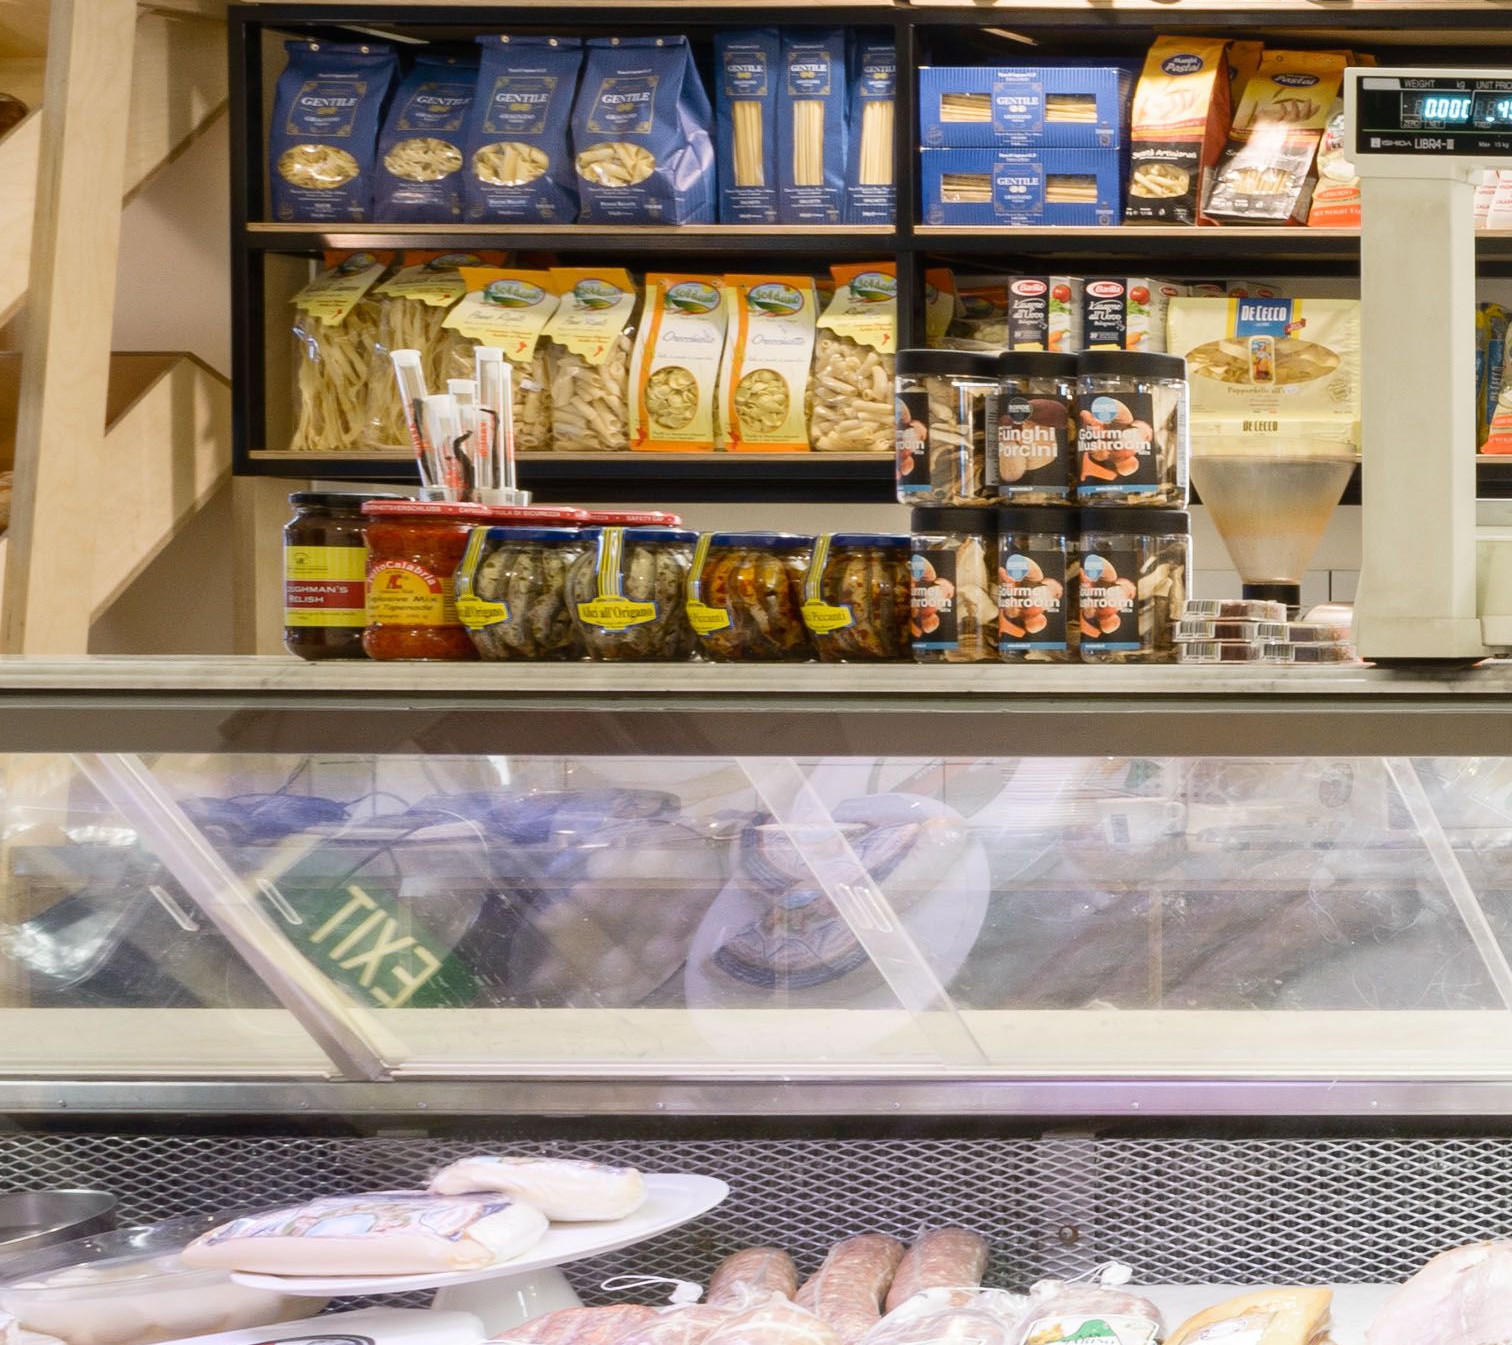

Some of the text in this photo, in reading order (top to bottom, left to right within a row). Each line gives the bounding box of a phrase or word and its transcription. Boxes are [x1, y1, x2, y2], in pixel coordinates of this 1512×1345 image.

[1404, 80, 1465, 89] WEIGHT kg
[1476, 81, 1493, 90] UNIT
[301, 95, 357, 107] GENTILE
[997, 96, 1038, 106] GENTILE
[1256, 304, 1287, 322] CECCO
[1255, 421, 1278, 432] CECCO
